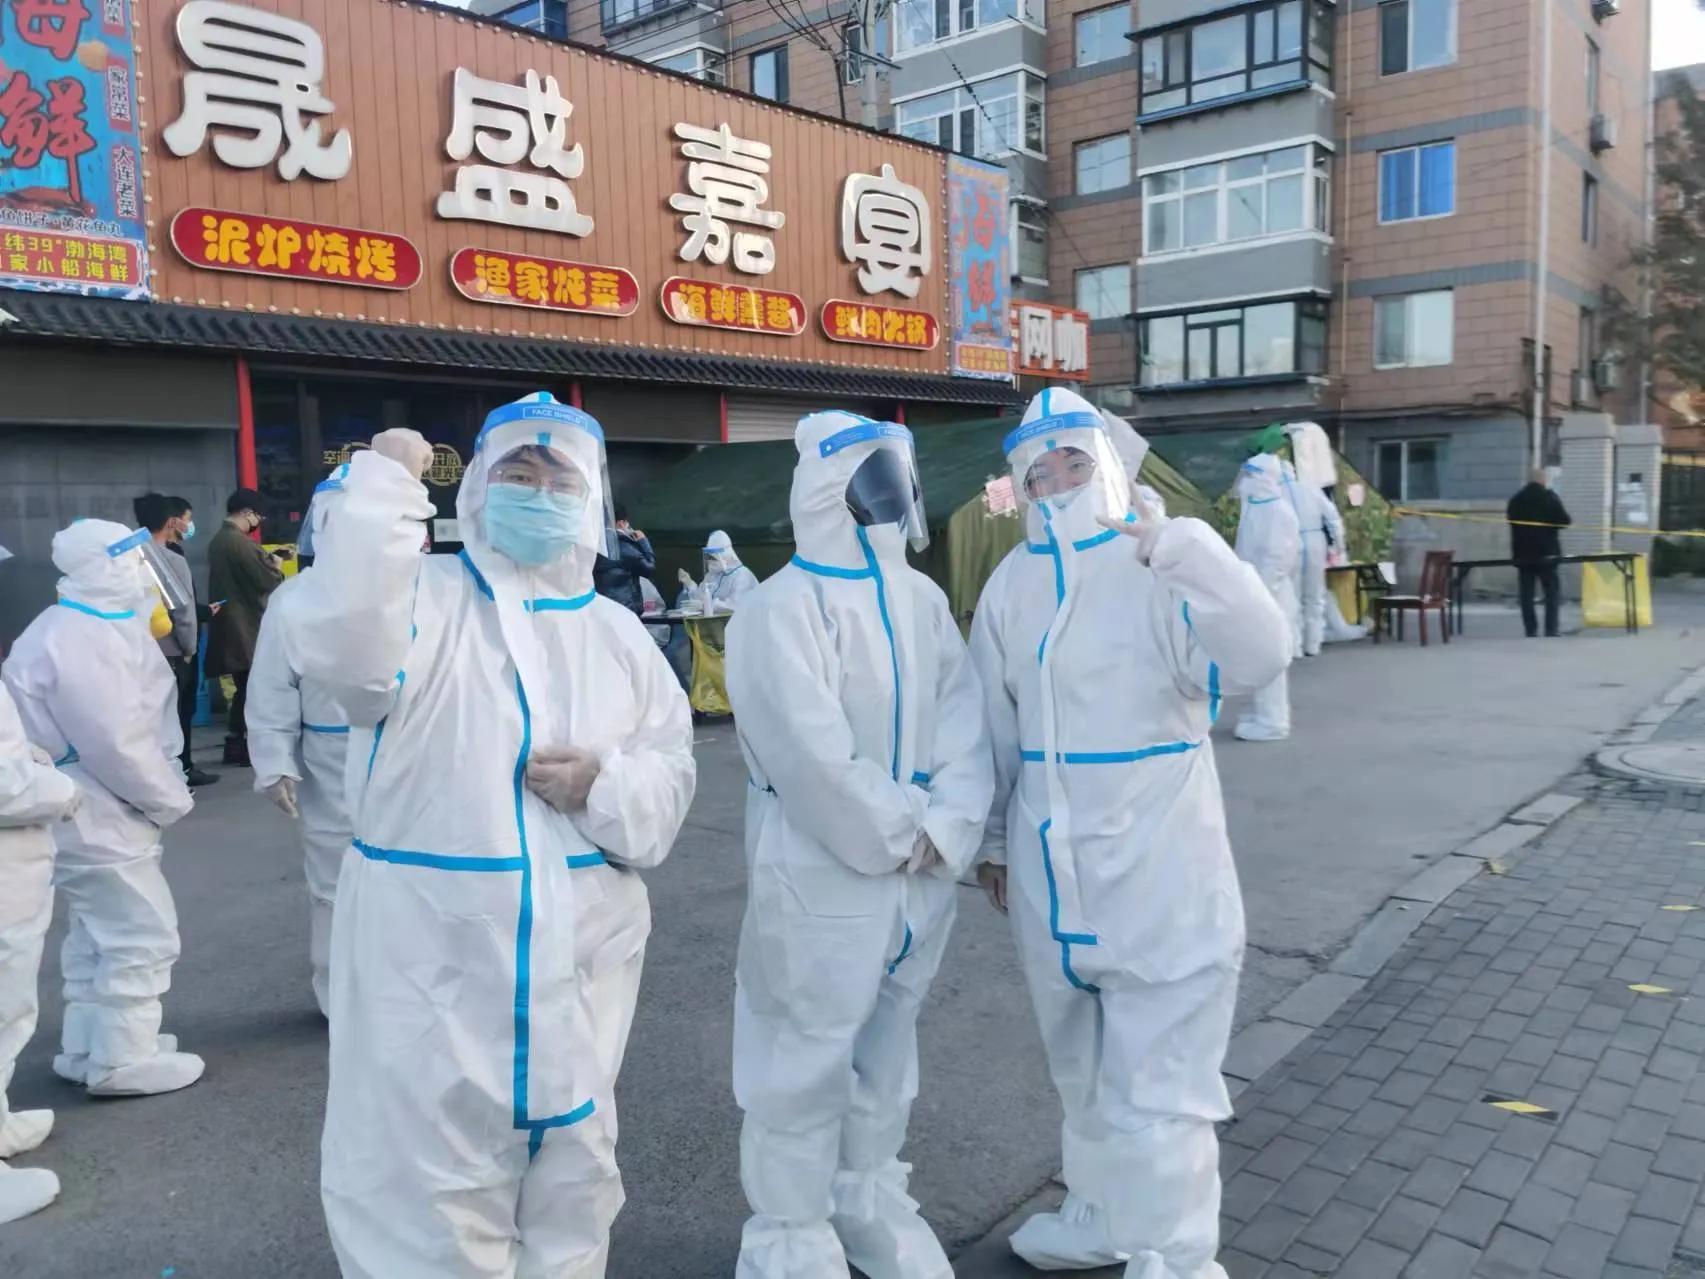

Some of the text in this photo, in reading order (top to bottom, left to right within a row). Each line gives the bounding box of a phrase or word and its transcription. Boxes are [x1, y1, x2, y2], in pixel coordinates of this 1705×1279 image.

[115, 147, 136, 217] 大连老菜
[164, 0, 932, 298] 晟盛嘉宴
[0, 253, 128, 282] 家小船海鲜
[202, 215, 397, 282] 泥炉烧烤
